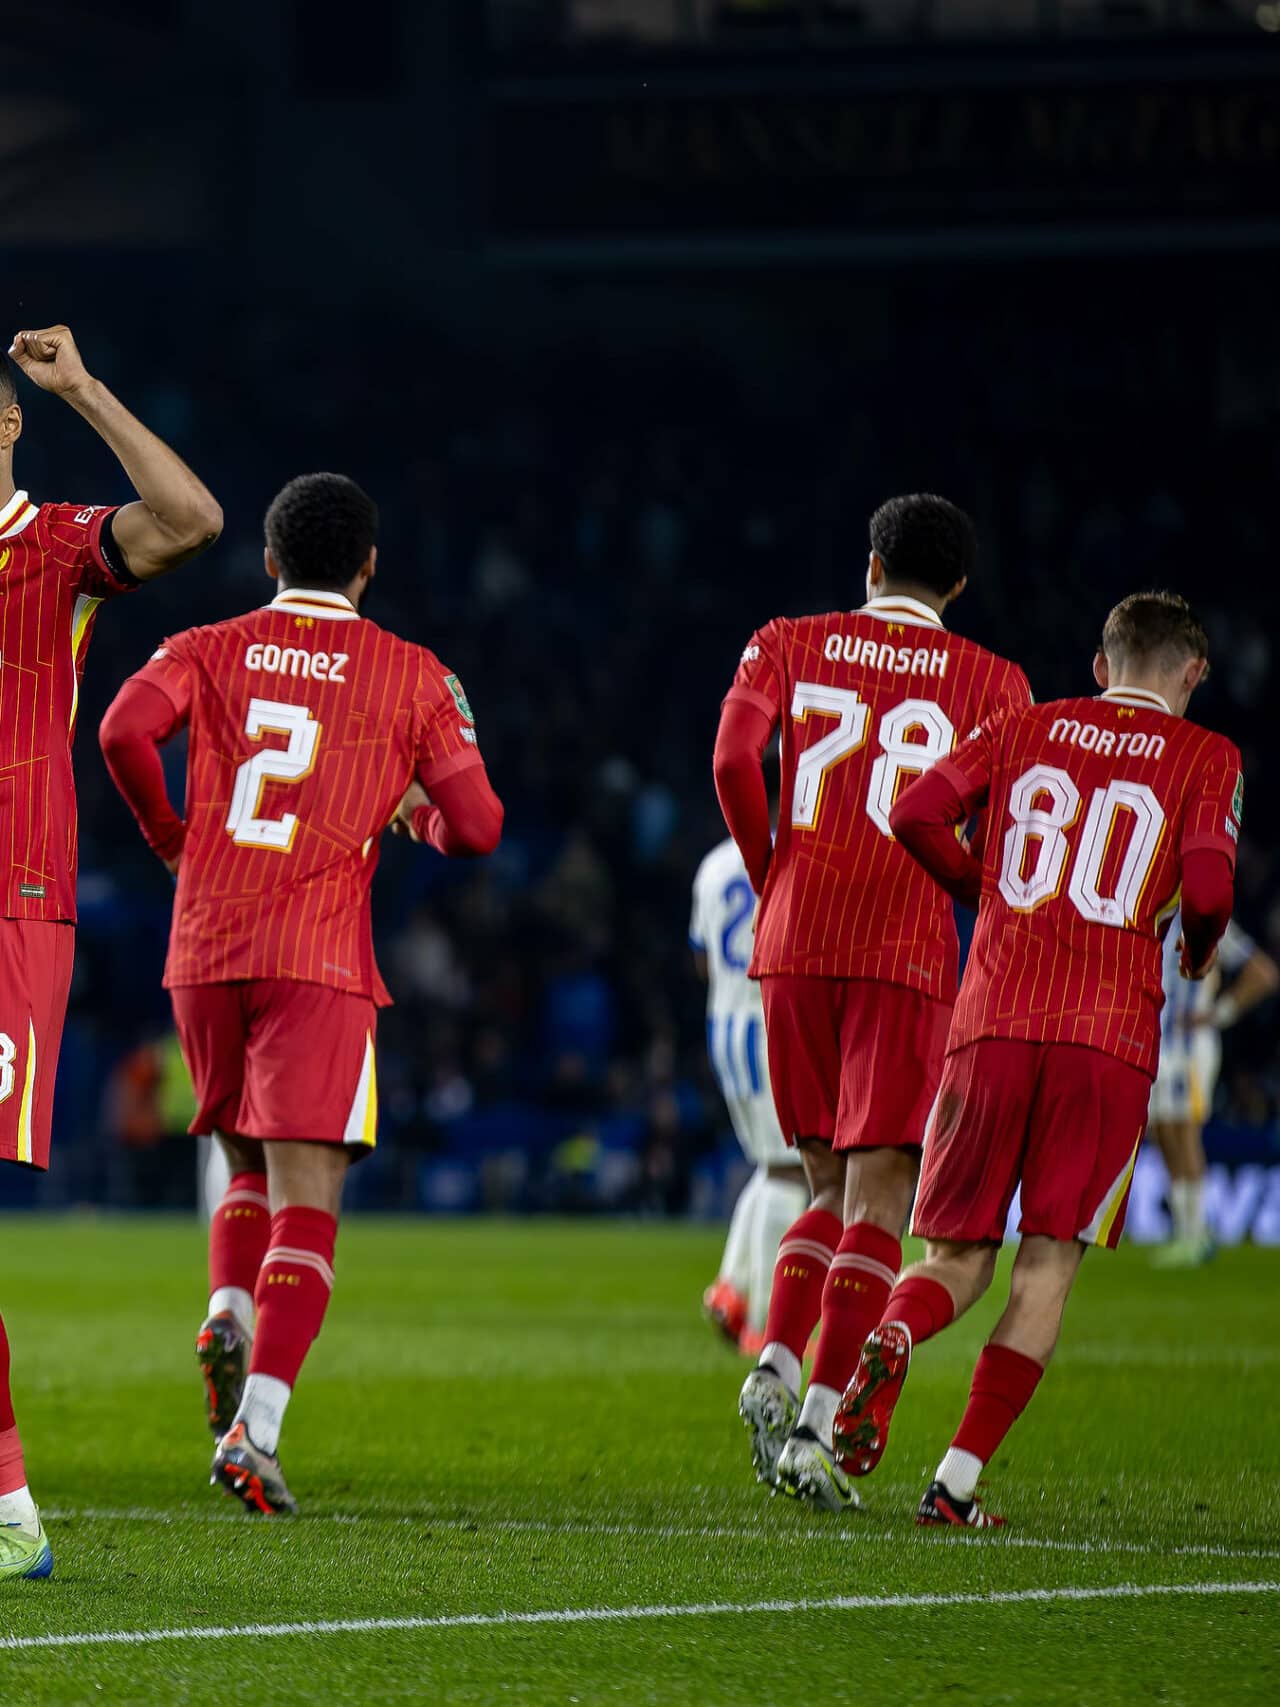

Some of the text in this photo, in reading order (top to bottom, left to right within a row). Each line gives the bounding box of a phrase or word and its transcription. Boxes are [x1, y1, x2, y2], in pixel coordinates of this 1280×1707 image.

[245, 643, 350, 683] GOMEZ
[824, 634, 949, 678] QUANSAH
[225, 697, 322, 854] 2
[791, 681, 957, 841] 78
[1049, 718, 1166, 760] MORTON
[998, 764, 1167, 928] 80
